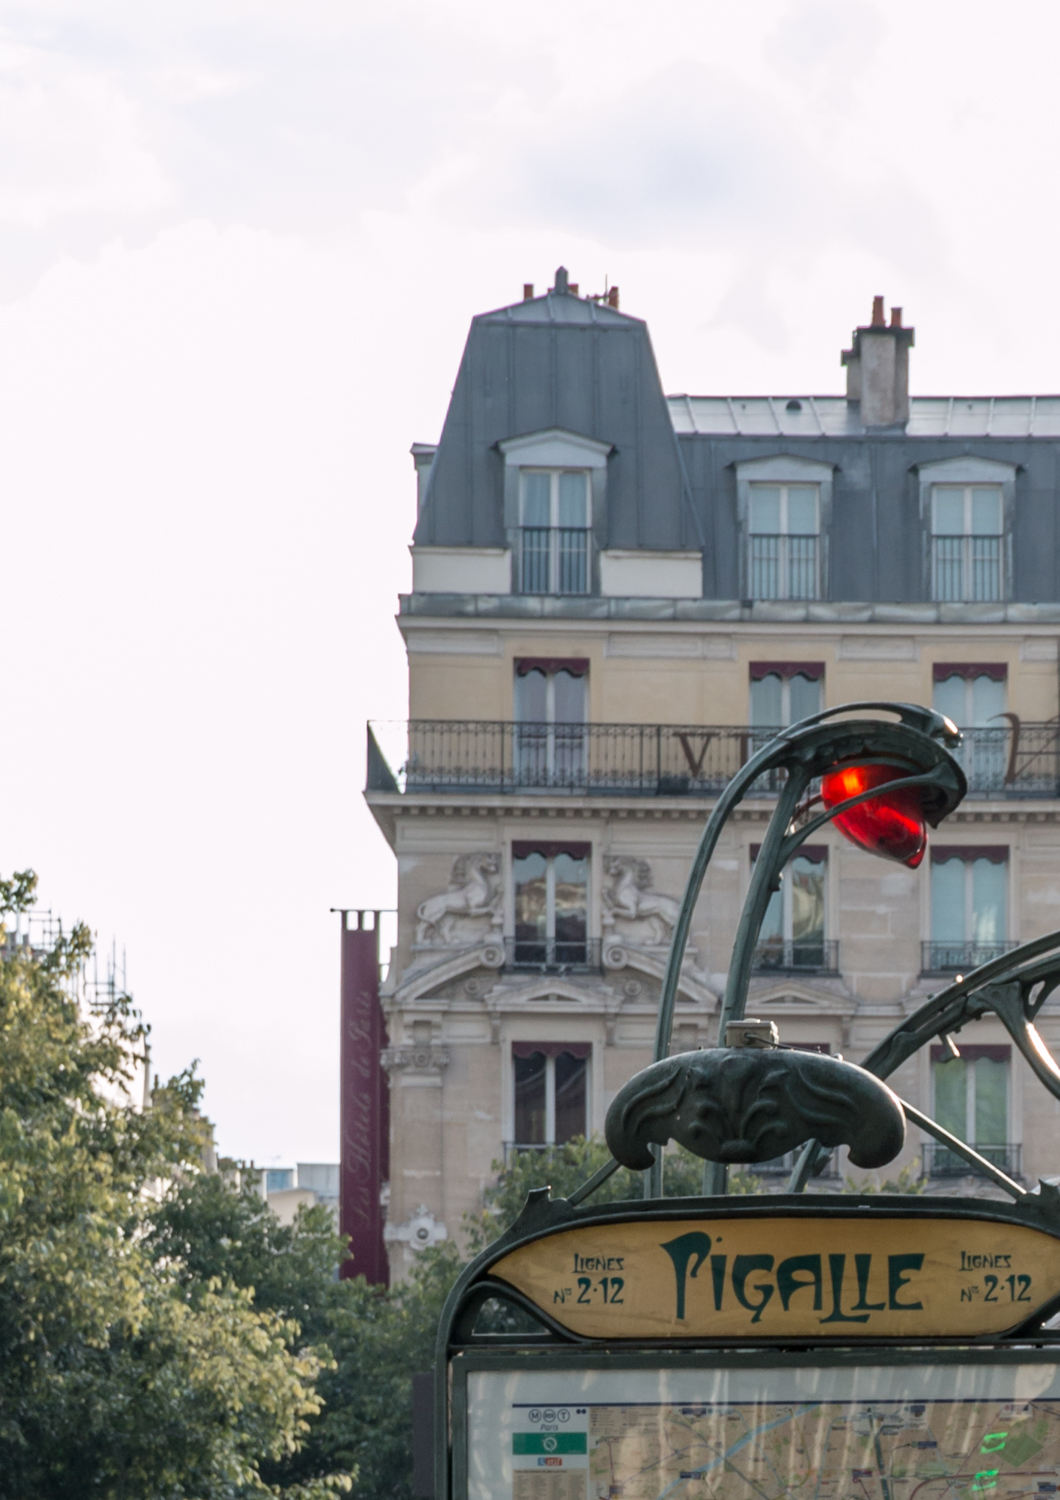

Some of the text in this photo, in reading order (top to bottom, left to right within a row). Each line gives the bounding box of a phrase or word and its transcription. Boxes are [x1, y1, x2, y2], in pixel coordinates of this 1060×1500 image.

[572, 1253, 625, 1273] LIGNES
[958, 1250, 1011, 1271] LIGNES
[658, 1231, 926, 1324] PIGALLE
